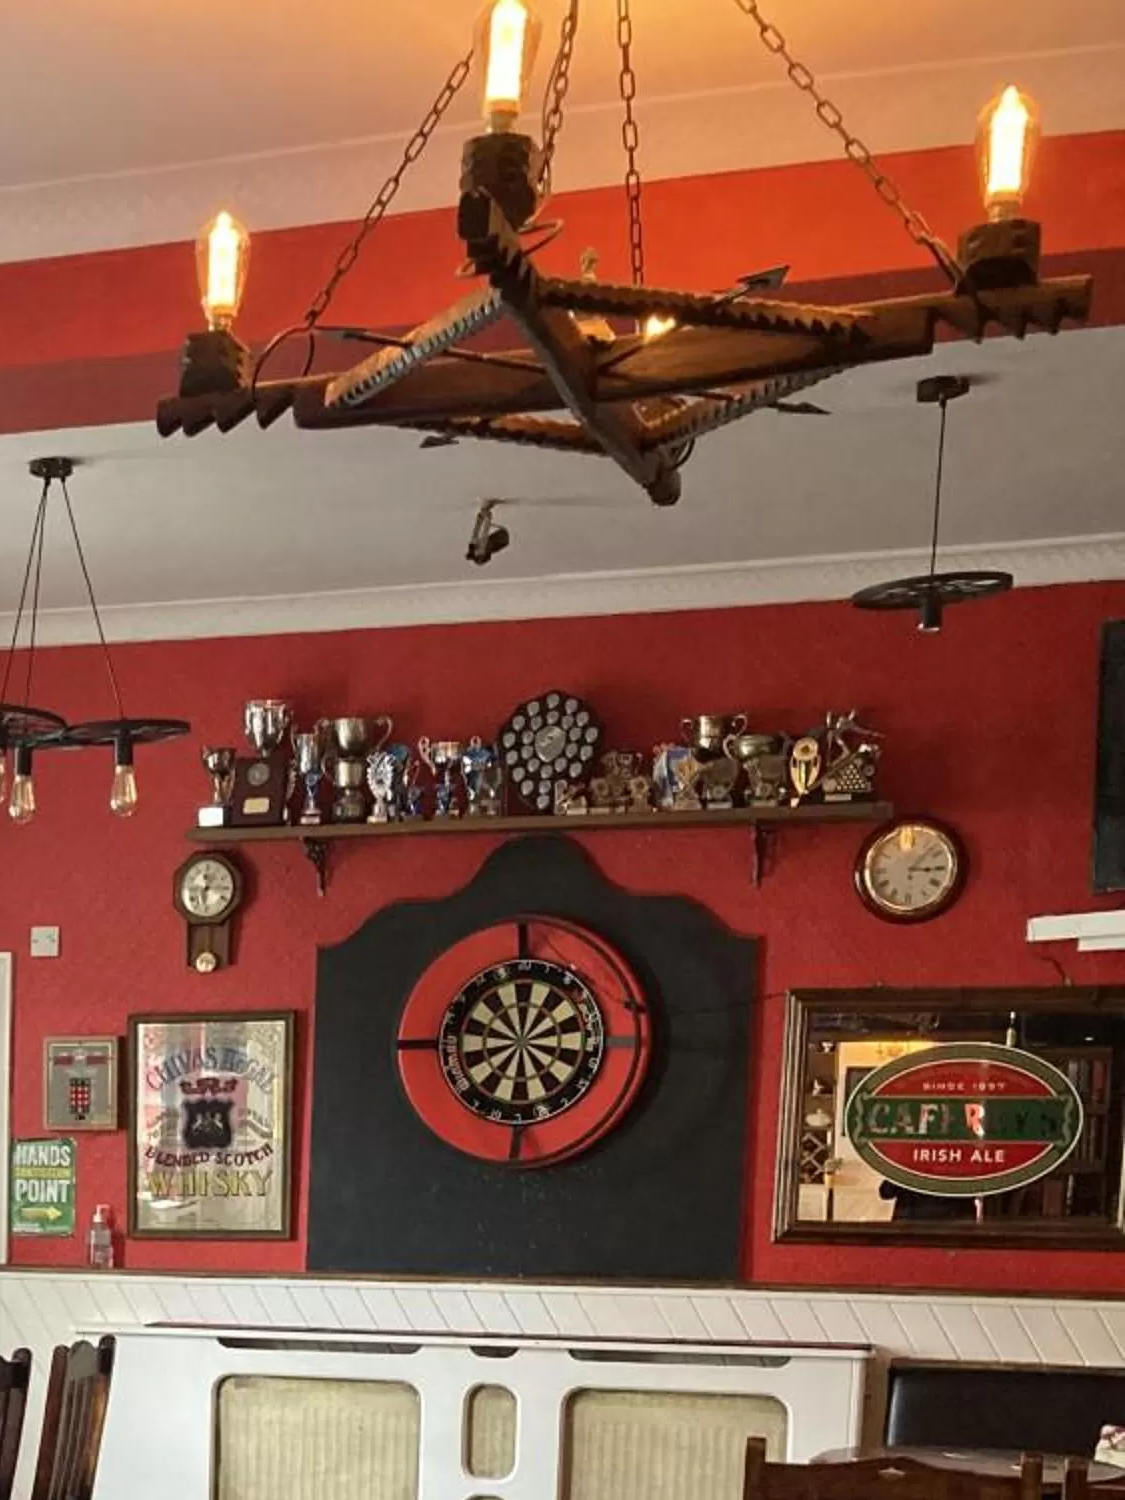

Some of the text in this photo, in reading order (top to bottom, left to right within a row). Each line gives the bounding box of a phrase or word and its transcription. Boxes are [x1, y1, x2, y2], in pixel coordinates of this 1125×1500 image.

[13, 1145, 72, 1167] HANDS
[145, 1142, 275, 1167] BLENDED SCOTCH
[913, 1148, 1005, 1163] IRISH ALE
[15, 1179, 71, 1204] POINT
[148, 1167, 273, 1197] WHISKY
